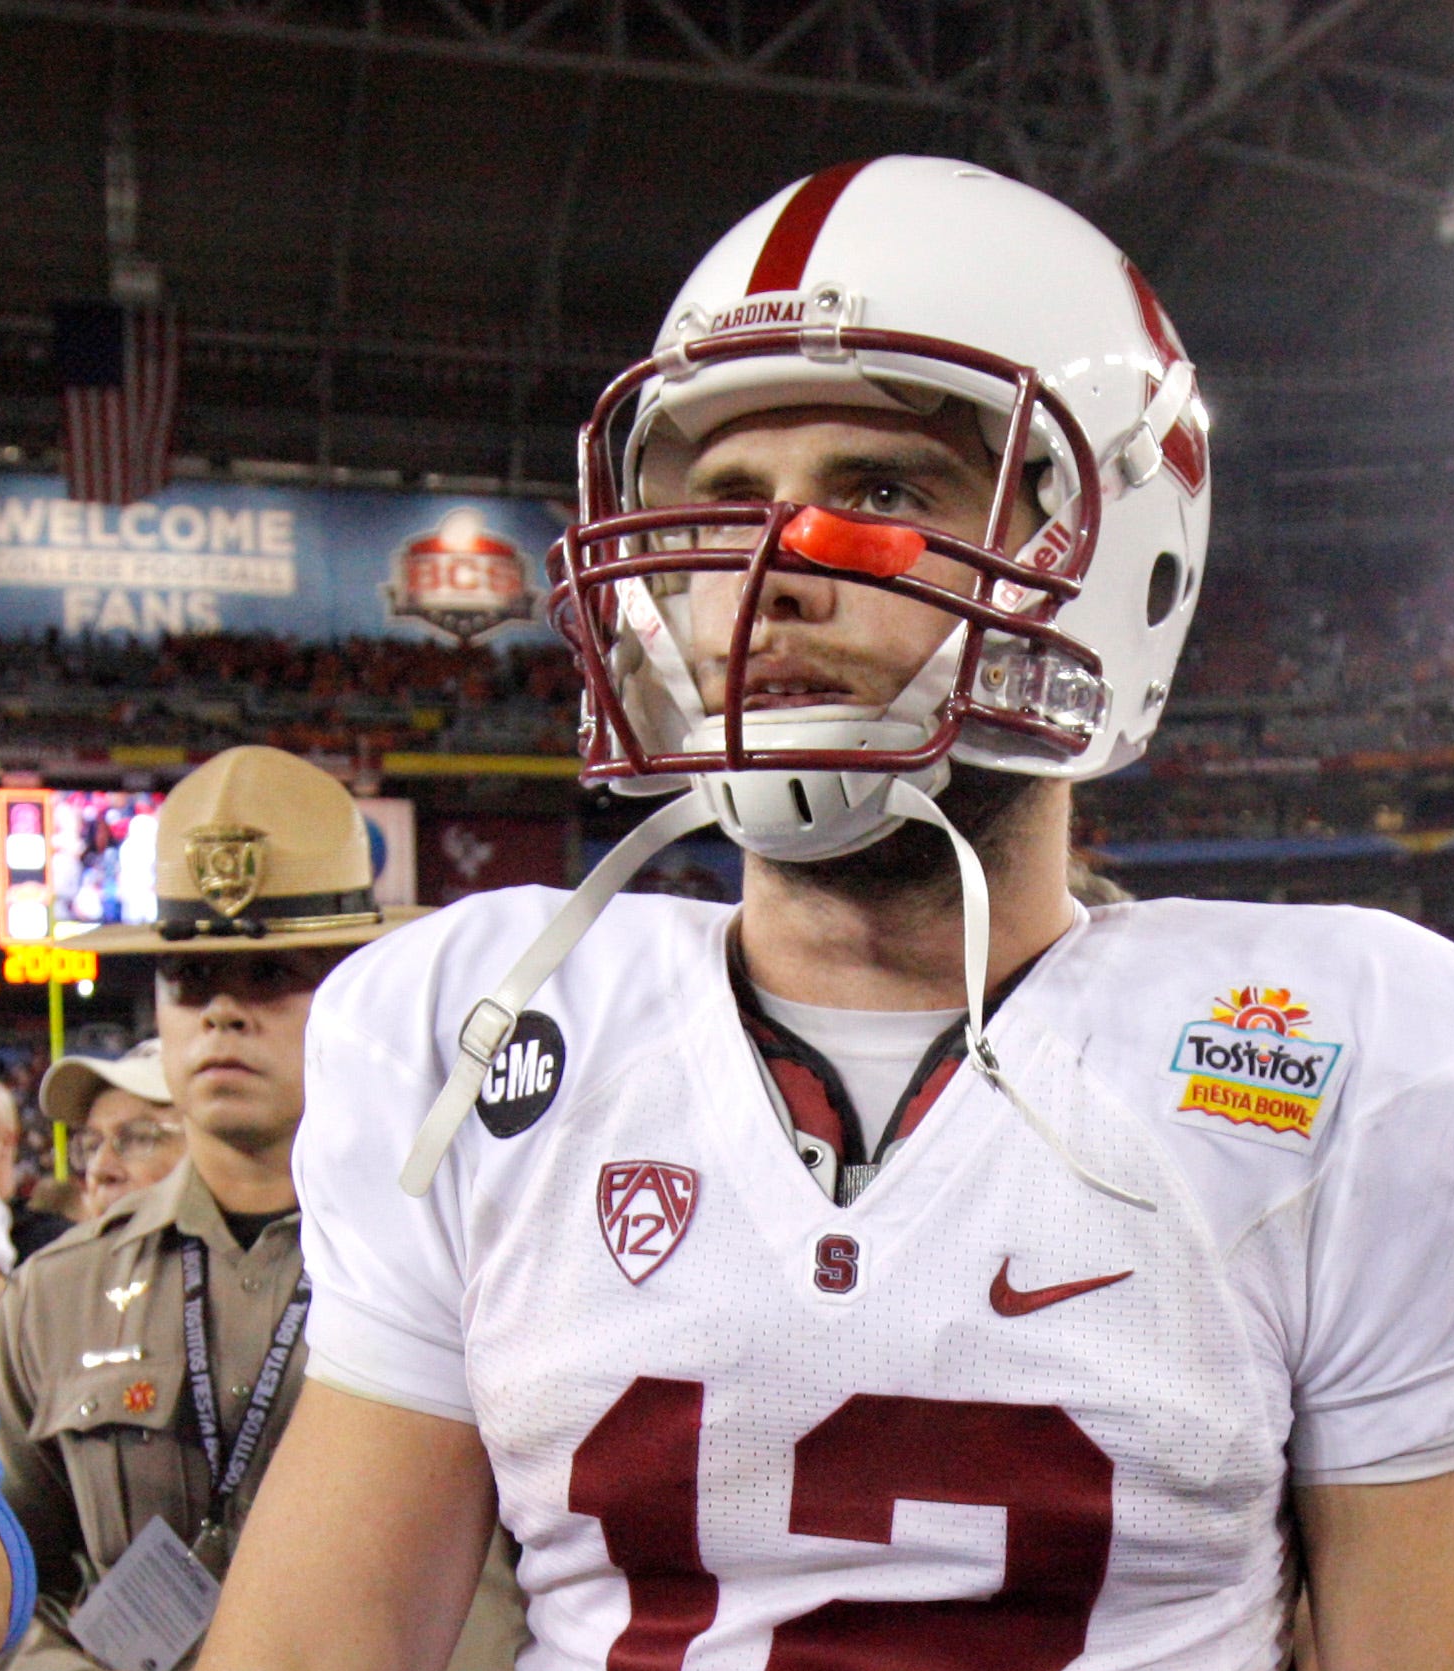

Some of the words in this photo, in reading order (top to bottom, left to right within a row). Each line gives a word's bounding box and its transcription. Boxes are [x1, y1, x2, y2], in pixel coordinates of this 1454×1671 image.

[132, 560, 288, 591] FOOTBALL
[406, 555, 523, 597] BCS
[62, 588, 224, 636] FANS
[1192, 1083, 1251, 1111] FIESTA
[1254, 1096, 1310, 1127] BOWL
[603, 1165, 693, 1236] PAC
[616, 1213, 665, 1256] 12
[815, 1233, 859, 1294] S
[184, 1296, 209, 1375] TOSTITOS
[191, 1374, 218, 1437] FIESTA
[217, 1407, 267, 1497] TOSTITOS
[251, 1346, 290, 1409] FIESTA
[274, 1301, 309, 1349] BOWL
